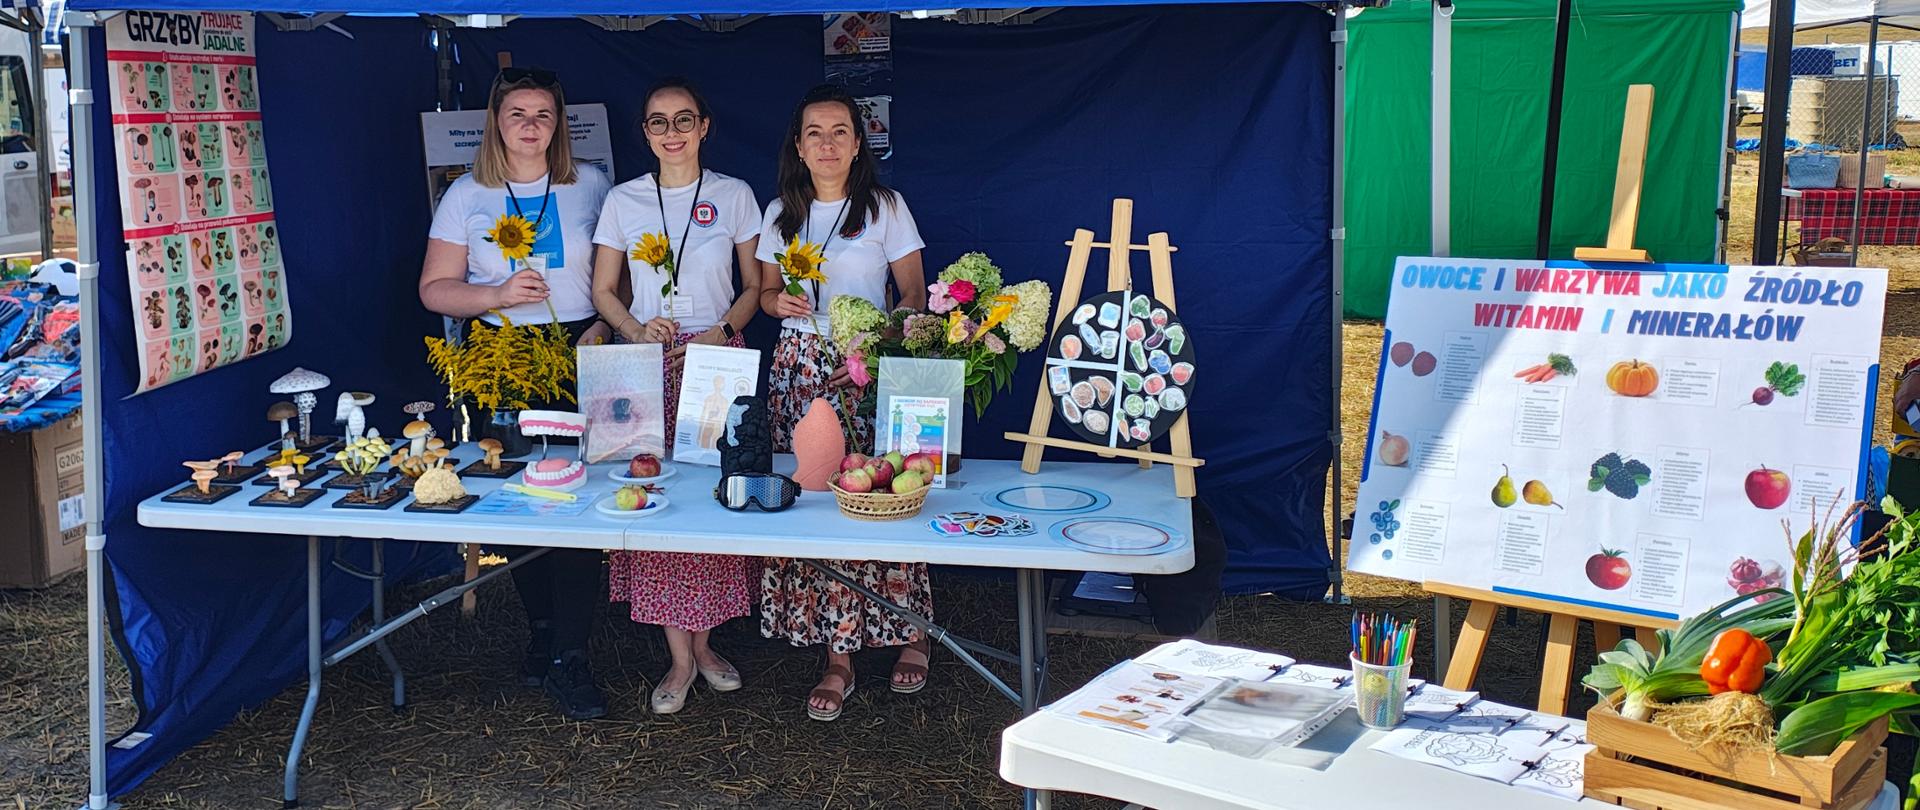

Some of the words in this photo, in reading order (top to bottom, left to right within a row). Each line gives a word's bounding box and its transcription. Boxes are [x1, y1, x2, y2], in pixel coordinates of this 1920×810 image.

[126, 10, 202, 46] GRZYBY
[201, 12, 243, 30] TRUJĄCE
[203, 35, 246, 52] JADALNE
[1400, 264, 1488, 291] OWOCE
[1493, 267, 1505, 291] I
[1515, 267, 1641, 296] WARZYWA
[1652, 273, 1729, 300] JAKO
[1743, 271, 1864, 307] ŹRÓDŁO
[1474, 303, 1584, 332] WITAMIN
[1600, 309, 1615, 334] I
[1627, 308, 1805, 342] MINERAŁÓW
